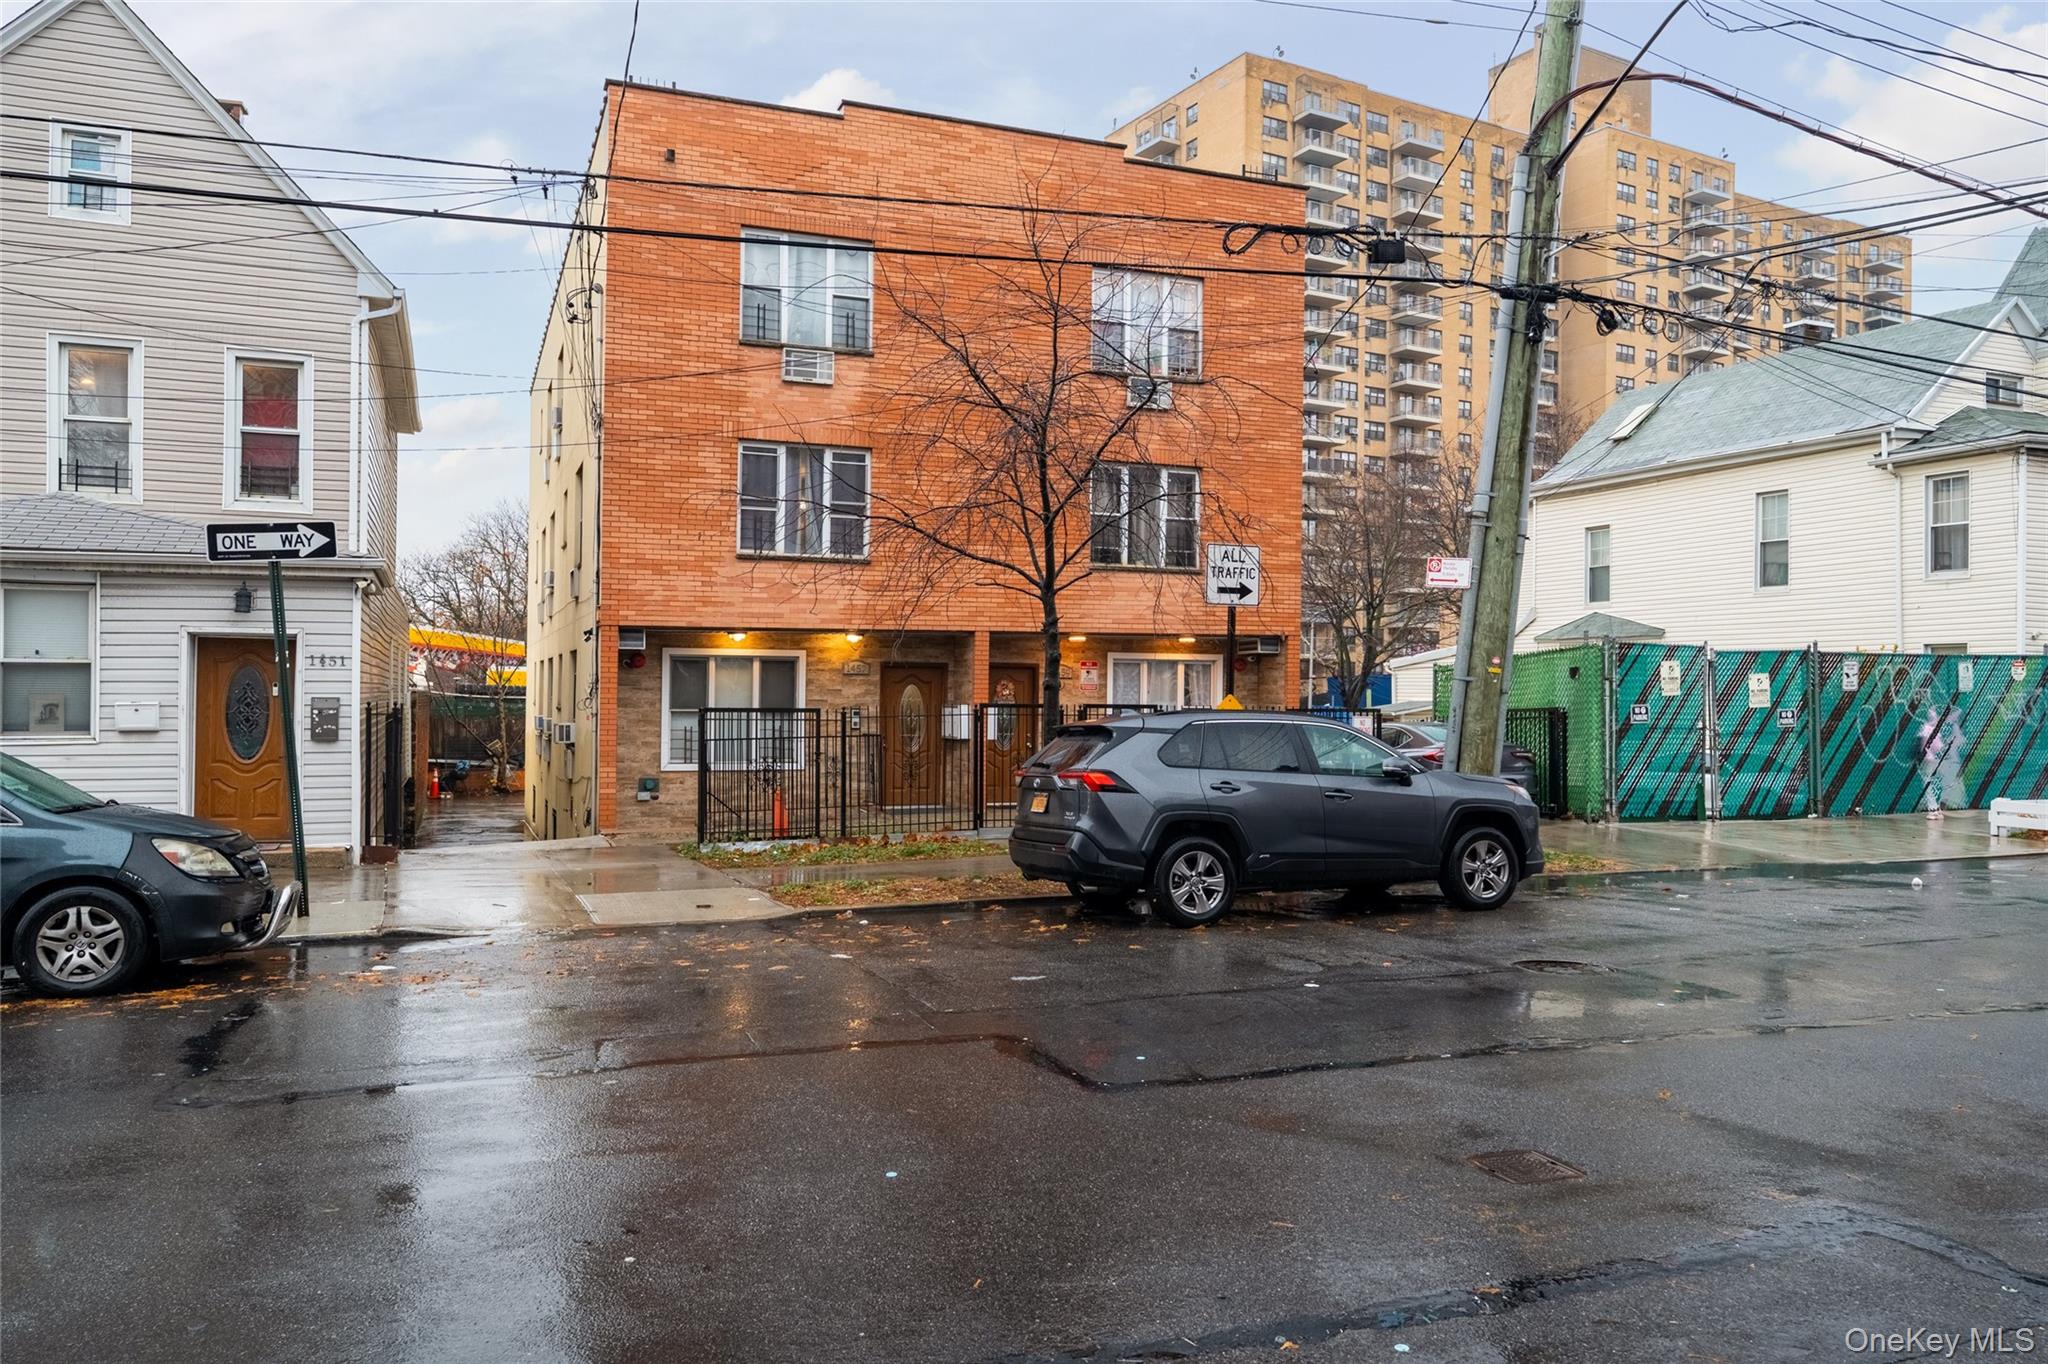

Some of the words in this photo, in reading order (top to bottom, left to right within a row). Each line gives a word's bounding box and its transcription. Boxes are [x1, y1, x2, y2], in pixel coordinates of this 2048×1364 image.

[222, 535, 256, 549] ONE
[280, 533, 315, 548] WAY
[1221, 550, 1245, 562] ALL
[1211, 566, 1256, 580] TRAFFIC
